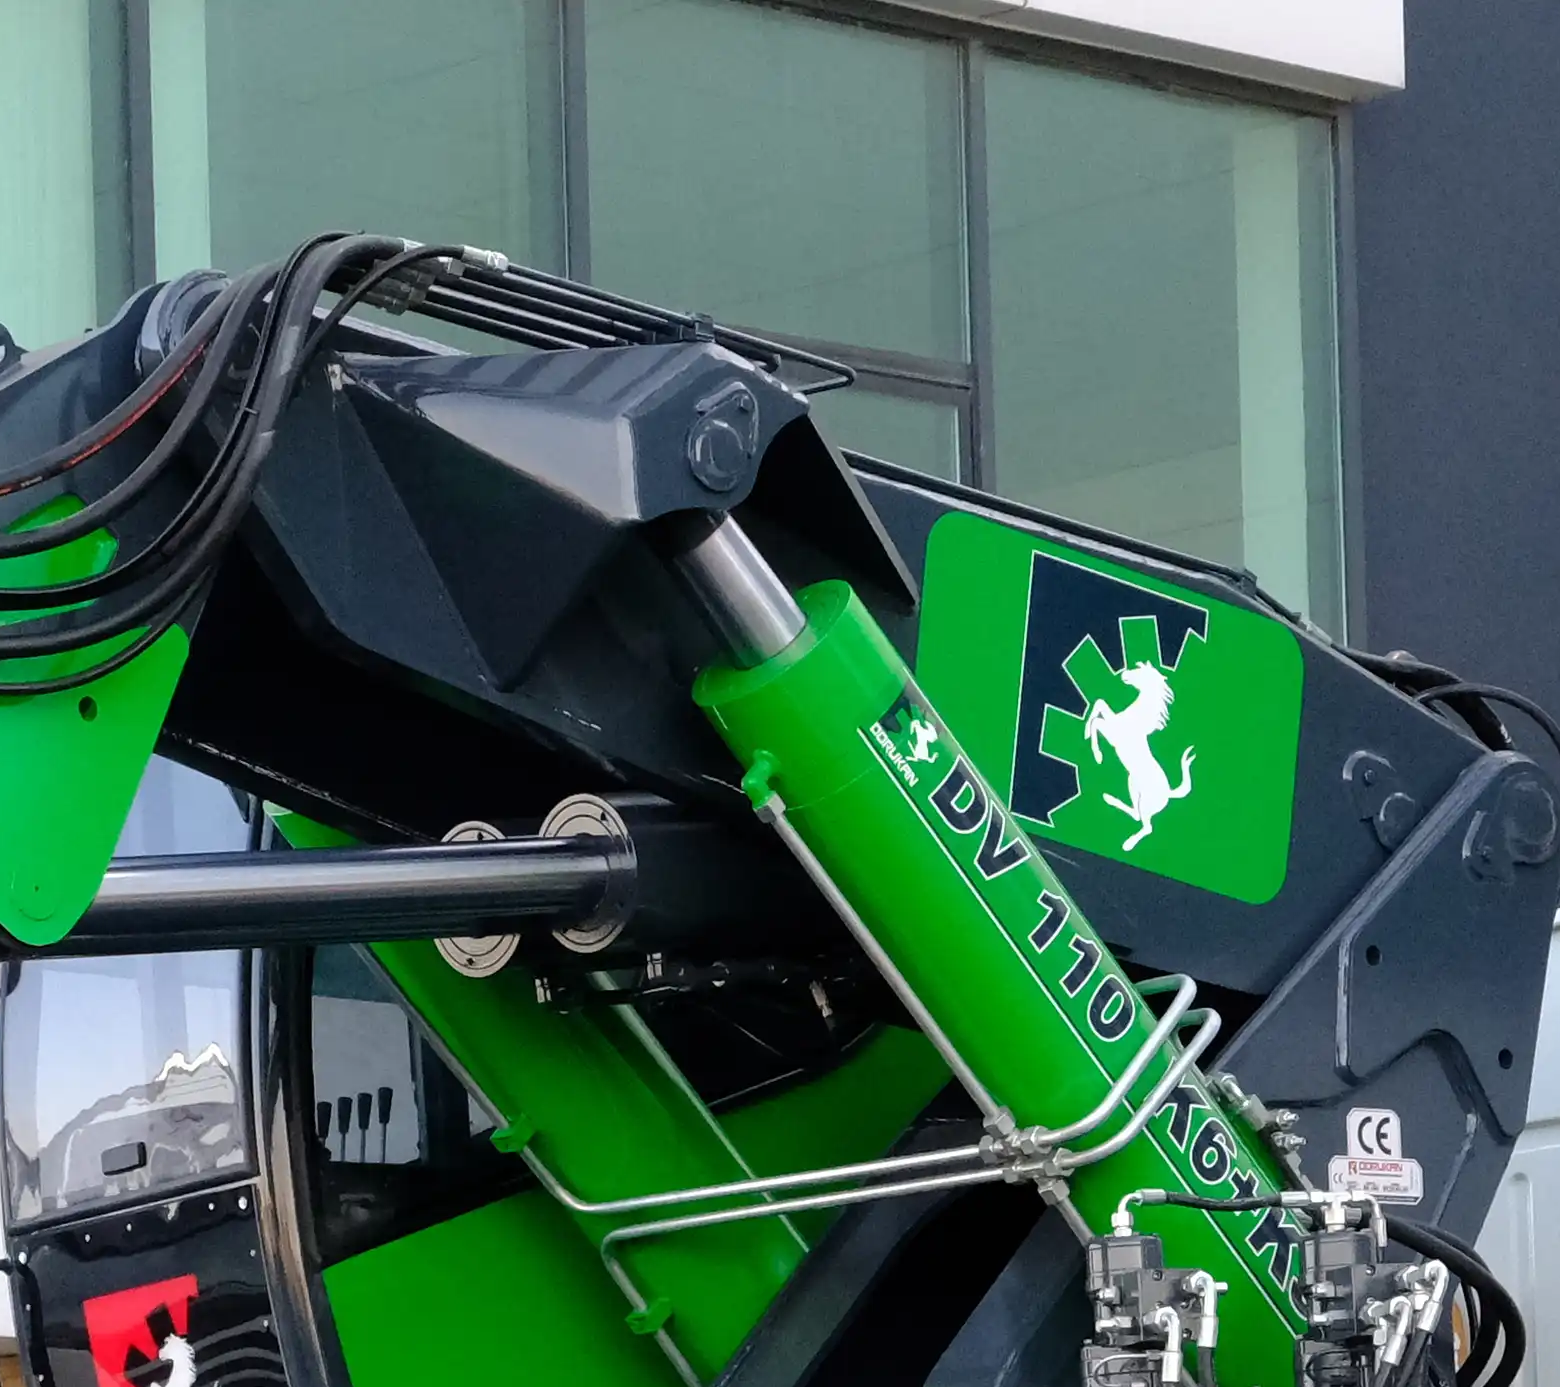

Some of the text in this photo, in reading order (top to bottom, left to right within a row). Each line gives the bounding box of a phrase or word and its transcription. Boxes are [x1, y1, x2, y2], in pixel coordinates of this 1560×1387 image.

[869, 721, 919, 788] DORUKAN
[928, 754, 1031, 880] DV
[1027, 888, 1136, 1042] 110
[1357, 1116, 1392, 1155] CE
